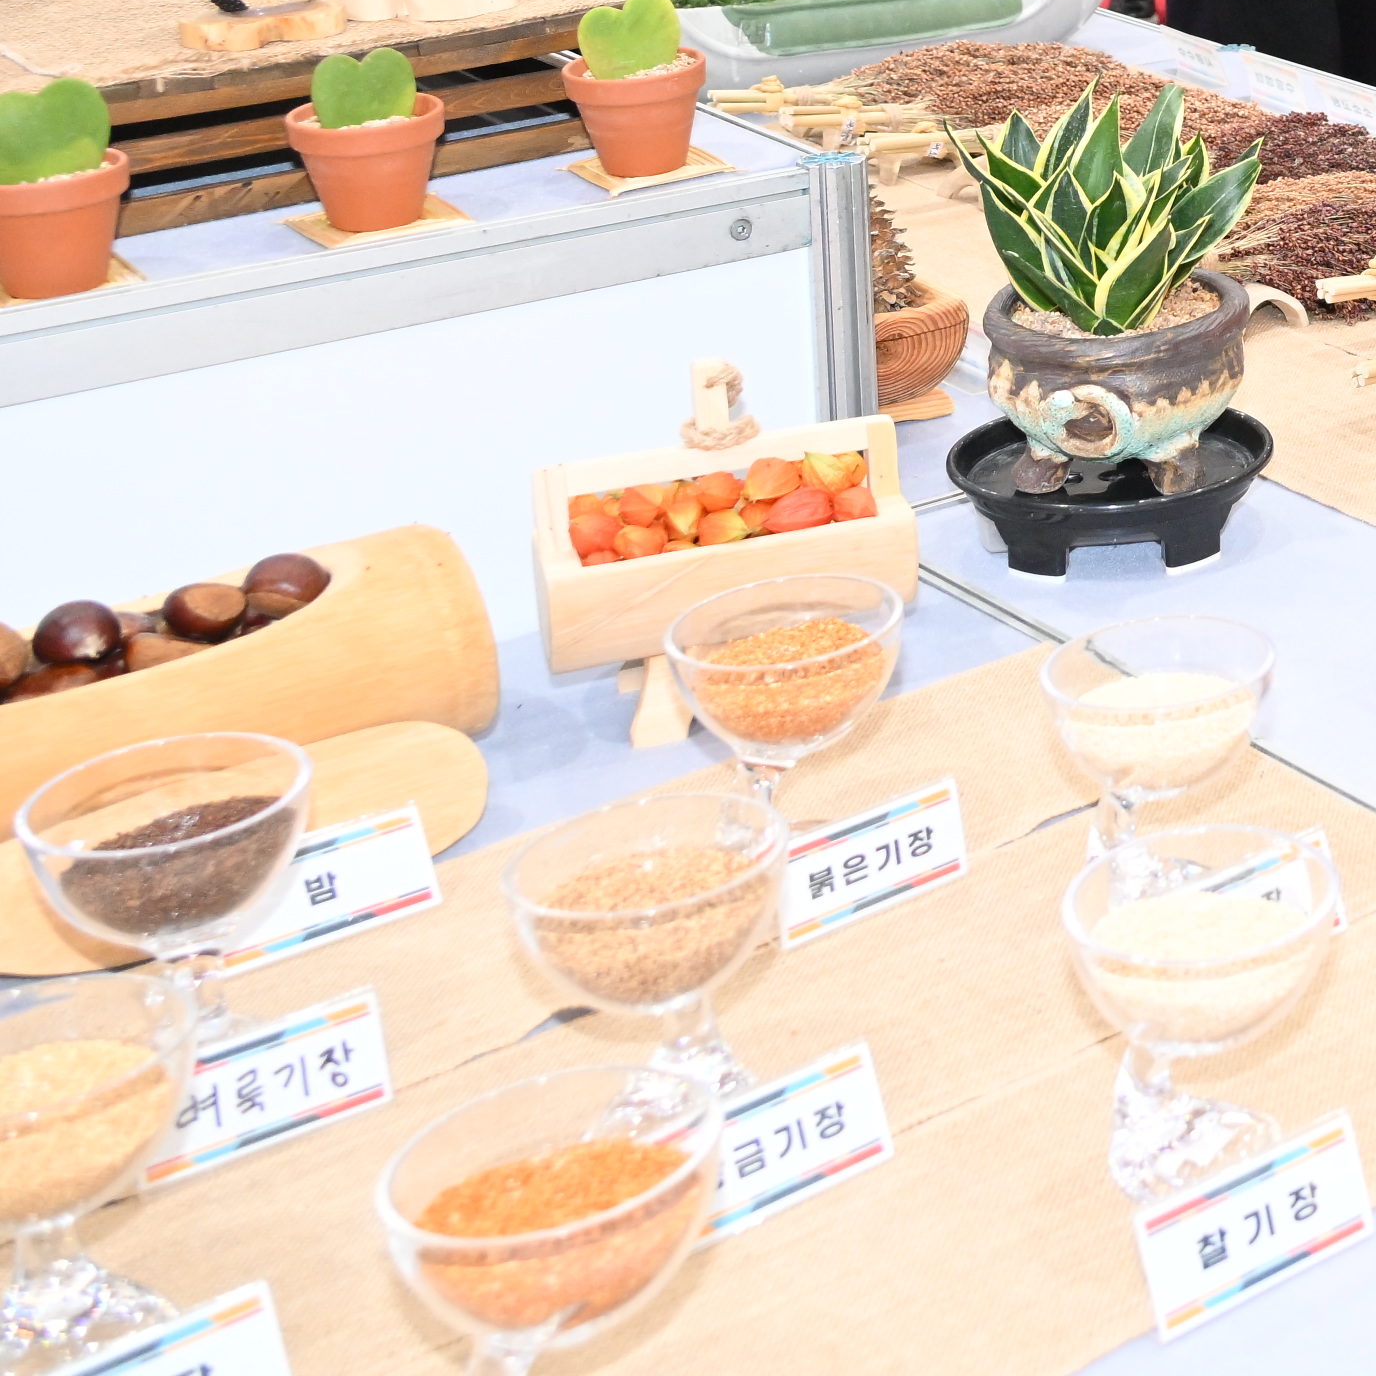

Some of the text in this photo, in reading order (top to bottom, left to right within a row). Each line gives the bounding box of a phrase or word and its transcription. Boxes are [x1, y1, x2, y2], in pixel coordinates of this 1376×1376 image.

[304, 870, 338, 907] 밤
[808, 825, 934, 900] 붉은기장
[718, 1100, 846, 1190] 금기장
